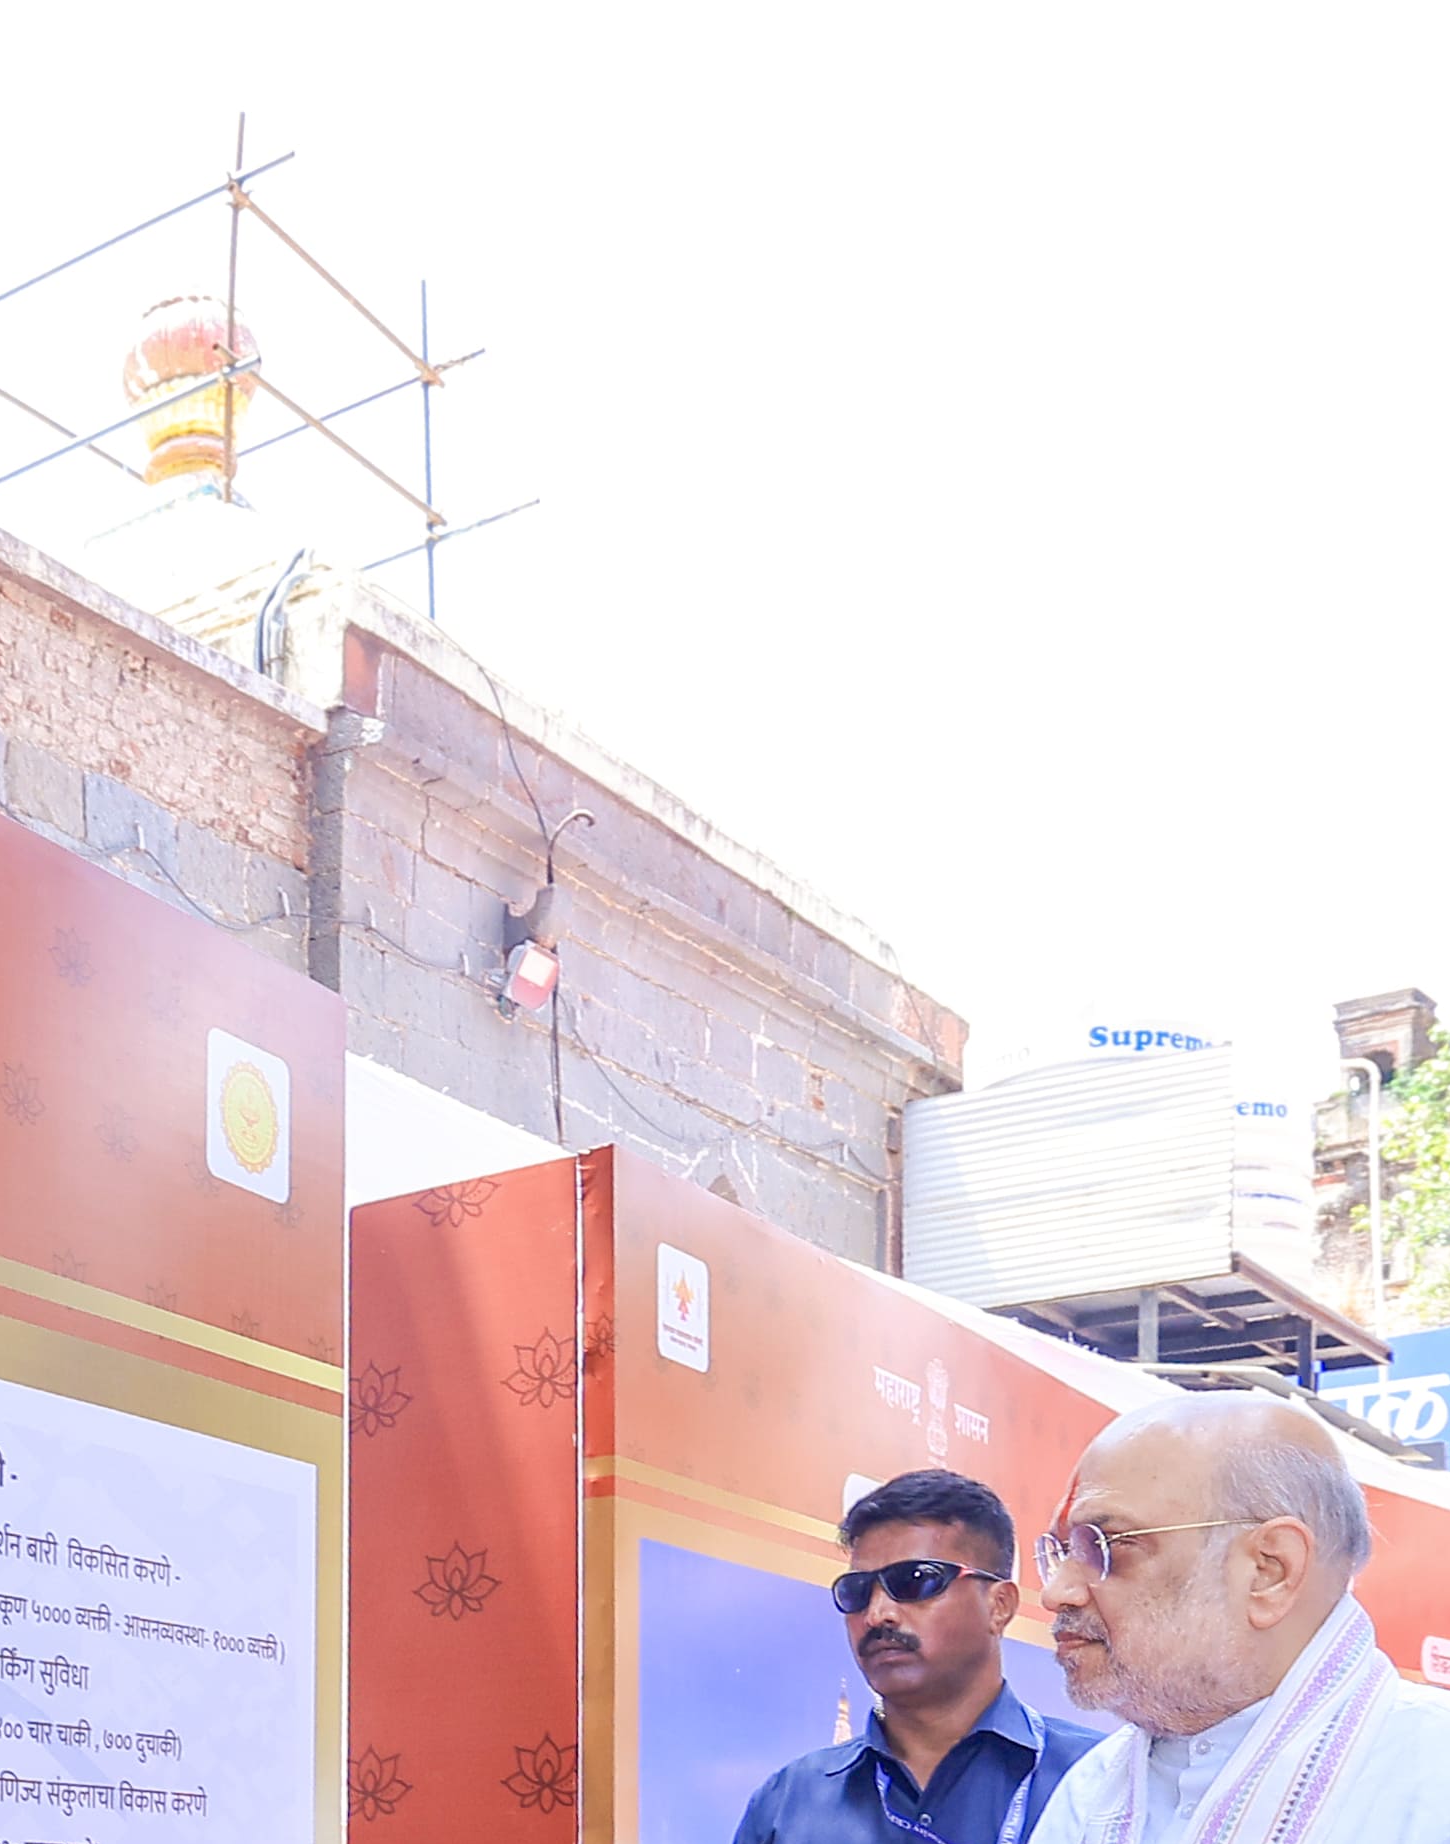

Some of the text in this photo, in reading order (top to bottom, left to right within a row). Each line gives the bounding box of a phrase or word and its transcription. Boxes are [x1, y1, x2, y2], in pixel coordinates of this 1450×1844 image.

[1088, 1026, 1213, 1051] Suprem
[26, 1532, 58, 1566] बारी
[67, 1538, 130, 1579] विकसित
[133, 1555, 171, 1587] करणे
[31, 1600, 71, 1625] ५०००
[74, 1603, 111, 1633] व्यक्ती
[39, 1655, 89, 1696] सुविधा
[27, 1720, 53, 1745] चार
[46, 1776, 116, 1817] संकुलाचा
[119, 1780, 167, 1815] विकास
[170, 1786, 208, 1817] करणे
